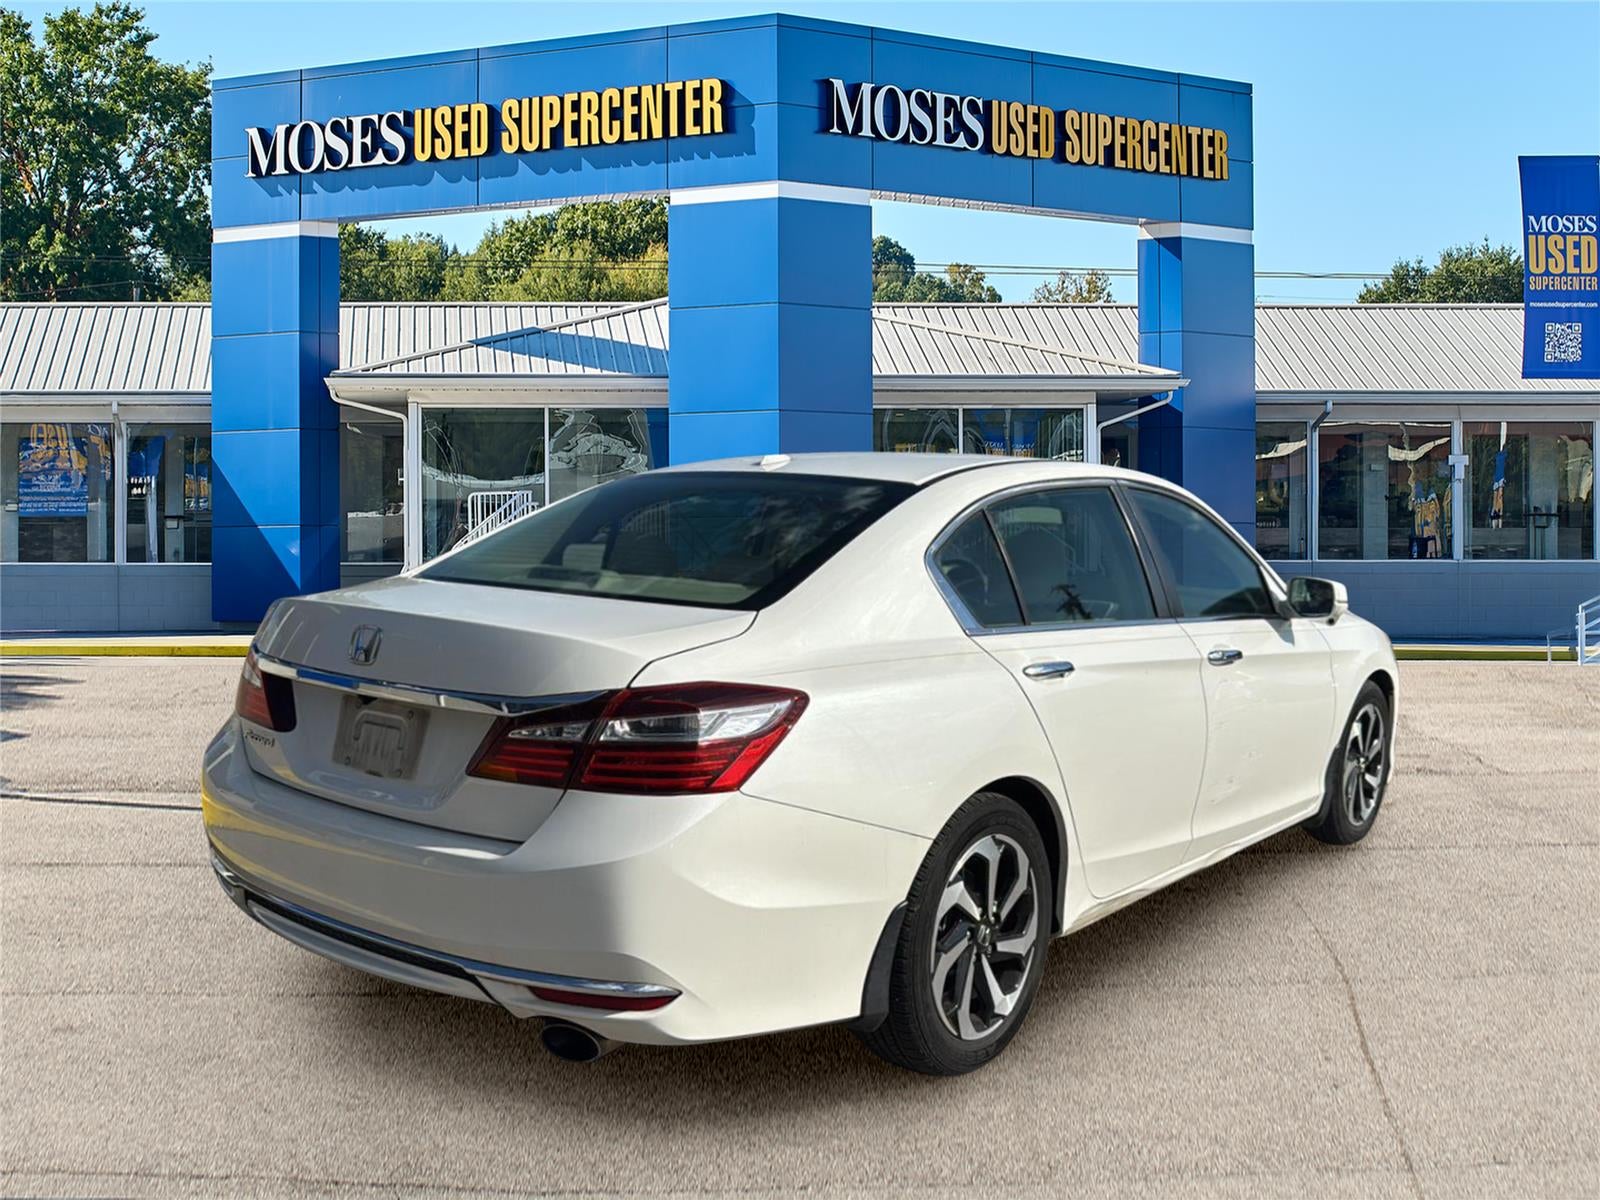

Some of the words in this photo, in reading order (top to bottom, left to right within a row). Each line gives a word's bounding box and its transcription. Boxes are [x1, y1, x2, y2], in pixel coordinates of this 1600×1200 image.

[244, 111, 407, 178] MOSES
[413, 102, 489, 162] USED
[501, 78, 724, 154] SUPERCENTER
[828, 78, 985, 152] MOSES
[991, 100, 1056, 160] USED
[1065, 109, 1229, 181] SUPERCENTER
[1527, 214, 1597, 234] MOSES
[1528, 234, 1598, 275] USED
[1529, 275, 1598, 291] SUPERCENTER
